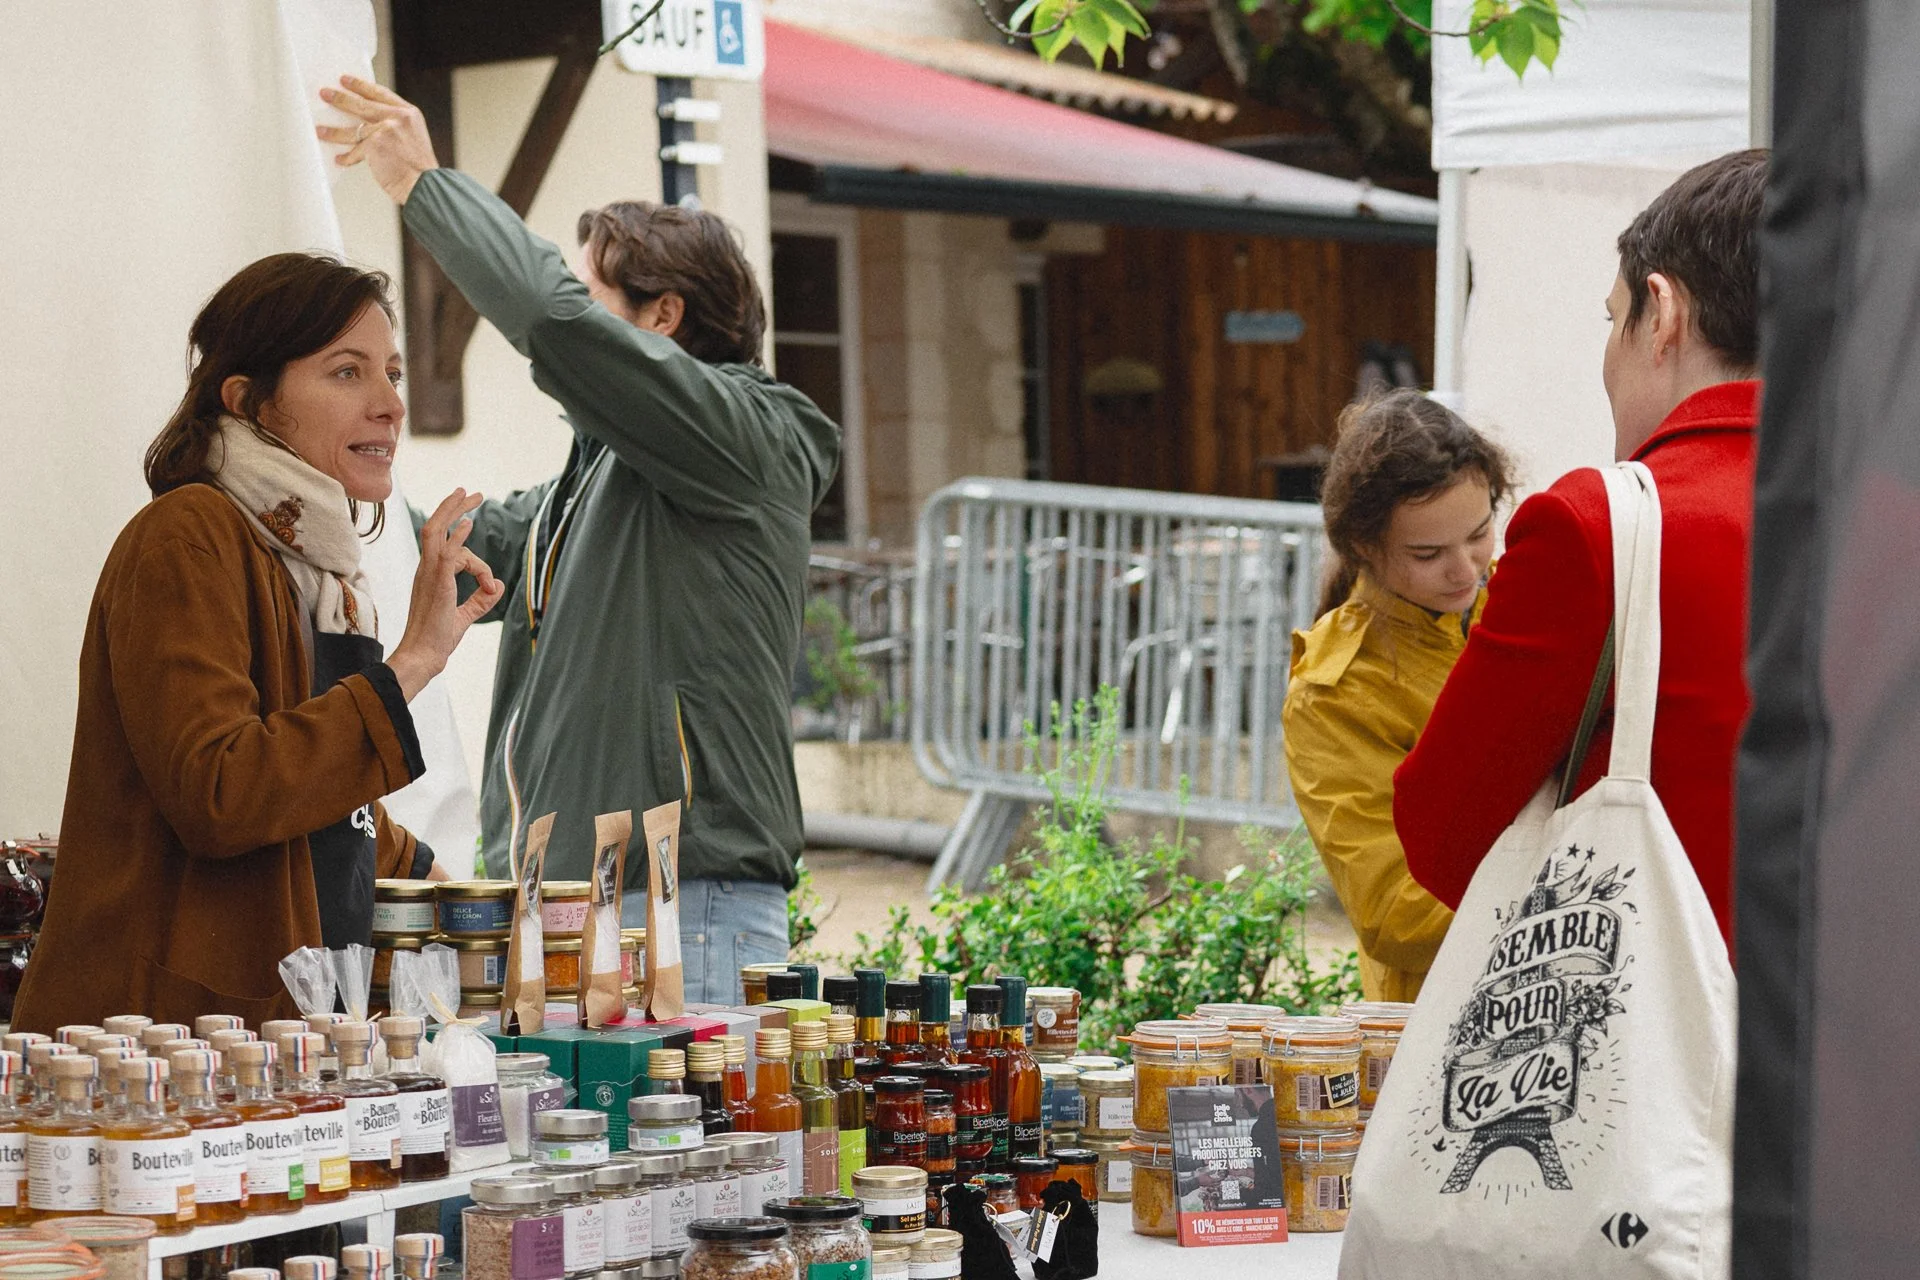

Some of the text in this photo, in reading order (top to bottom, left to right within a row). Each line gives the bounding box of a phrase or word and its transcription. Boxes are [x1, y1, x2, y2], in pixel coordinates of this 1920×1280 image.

[631, 2, 705, 48] SAUF
[1489, 910, 1612, 975] SEMBLE
[1487, 985, 1559, 1035] POUR
[1457, 1053, 1571, 1120] La Vie
[1213, 1115, 1233, 1123] chefs
[1199, 1136, 1253, 1149] LES MEILLEURS
[1192, 1147, 1262, 1160] PRODUITS DE CHEFS
[1208, 1158, 1248, 1171] CHEZ VOUS
[1192, 1218, 1216, 1234] 10%
